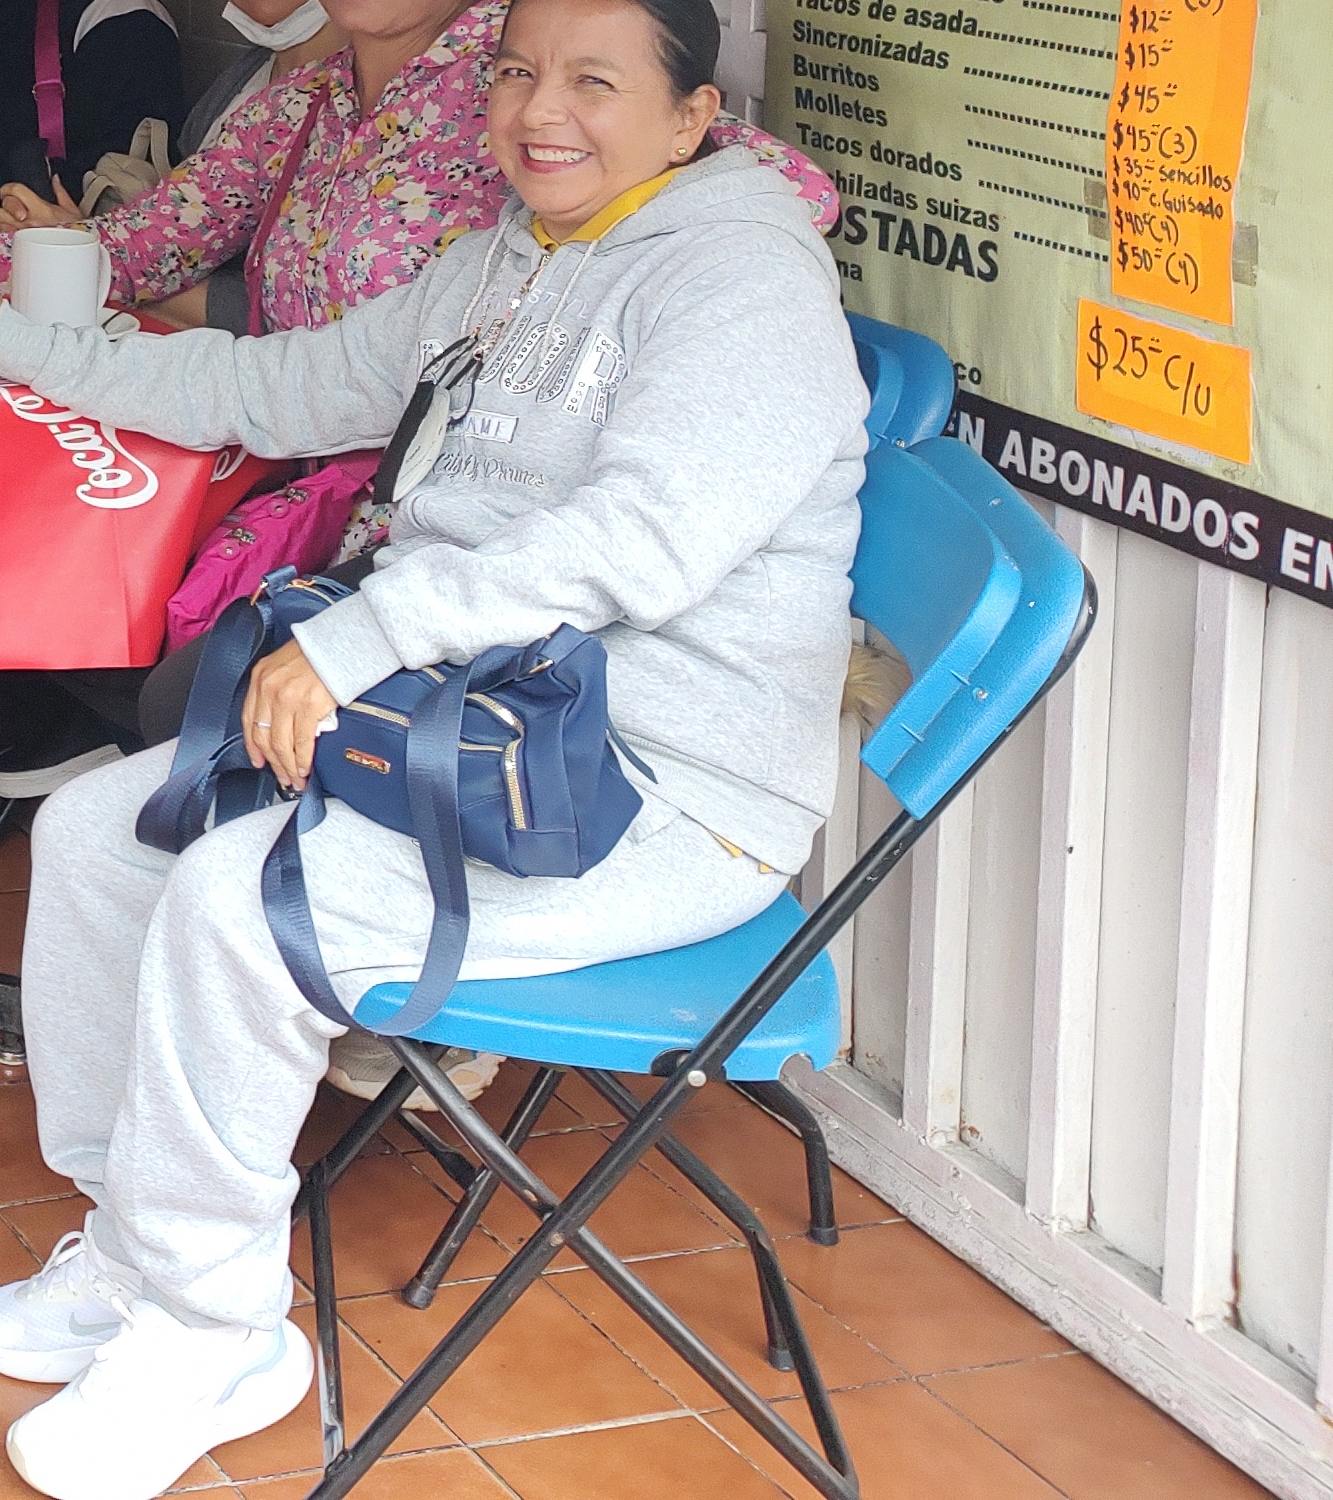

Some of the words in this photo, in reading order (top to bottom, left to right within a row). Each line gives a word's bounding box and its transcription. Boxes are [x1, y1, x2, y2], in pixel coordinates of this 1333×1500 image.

[792, 19, 951, 69] Sincronizadas
[793, 53, 881, 93] Burritos
[794, 86, 888, 128] Molletes
[796, 122, 864, 157] Tacos
[869, 139, 963, 182] dorados
[1158, 164, 1233, 193] sencillos
[926, 197, 1001, 232] suizas
[999, 429, 1260, 561] ABONADOS
